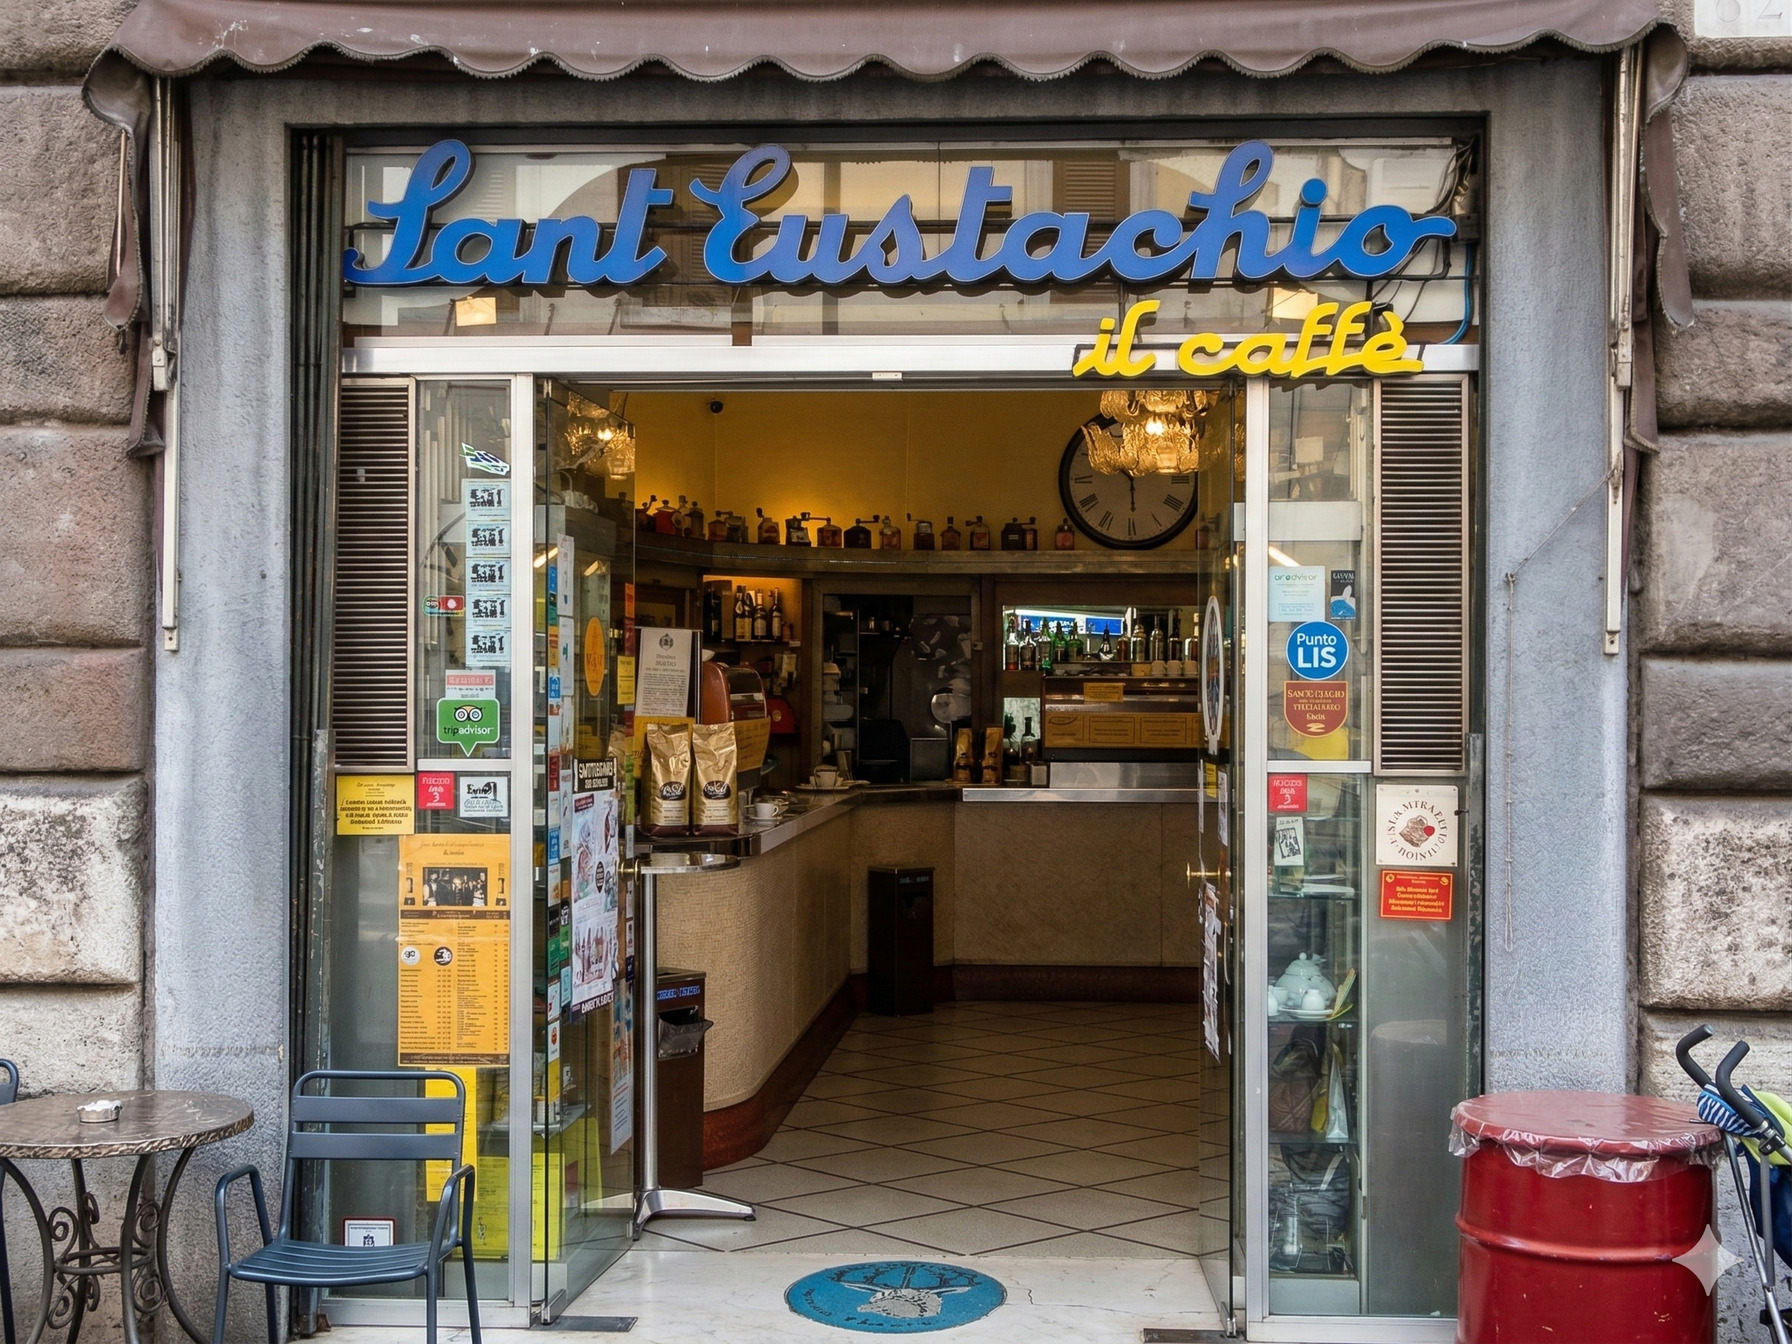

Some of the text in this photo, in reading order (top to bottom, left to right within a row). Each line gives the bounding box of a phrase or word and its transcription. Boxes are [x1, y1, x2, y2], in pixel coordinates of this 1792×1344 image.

[343, 140, 1457, 284] Sant Eustachio
[1073, 300, 1424, 378] il caffè
[1296, 632, 1337, 646] Punto
[1297, 647, 1337, 668] LIS
[443, 725, 492, 736] tripadvisor
